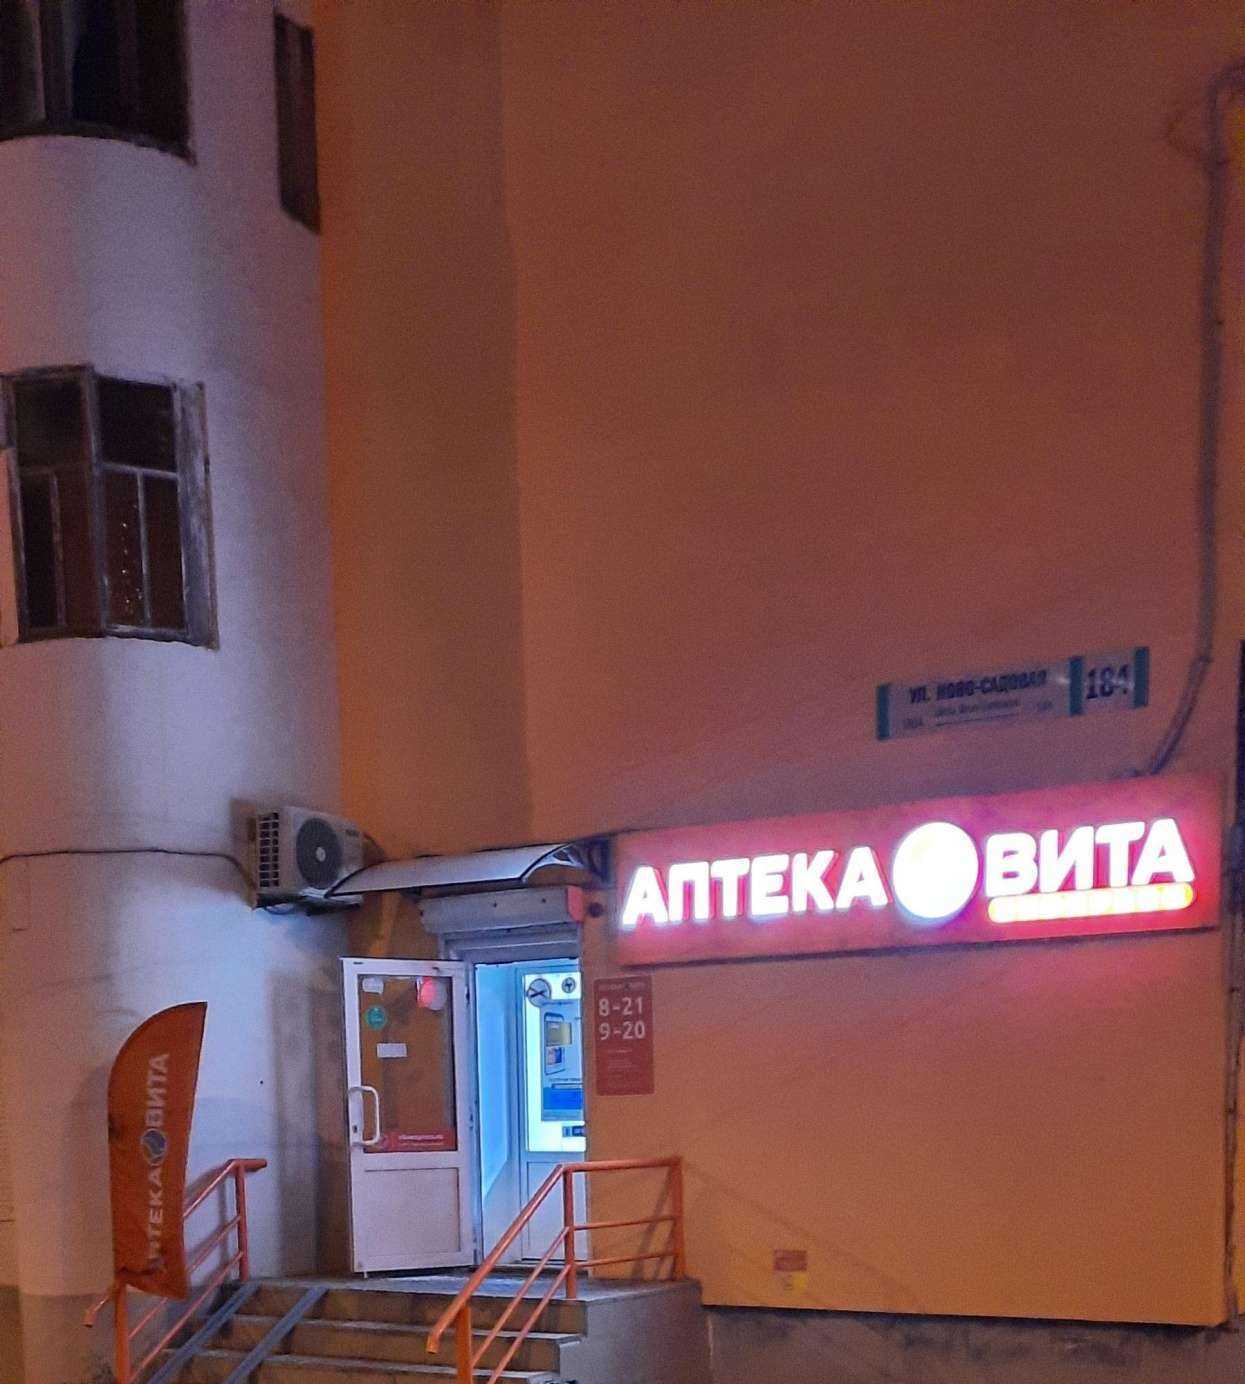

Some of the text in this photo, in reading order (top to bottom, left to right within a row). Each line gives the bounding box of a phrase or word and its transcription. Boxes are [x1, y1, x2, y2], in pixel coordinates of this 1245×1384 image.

[1086, 664, 1130, 700] 184
[621, 817, 1195, 926] АПТЕКА ВИТА
[599, 996, 644, 1017] 8-21
[599, 1020, 646, 1041] 9-20
[144, 1053, 169, 1129] ВИТА
